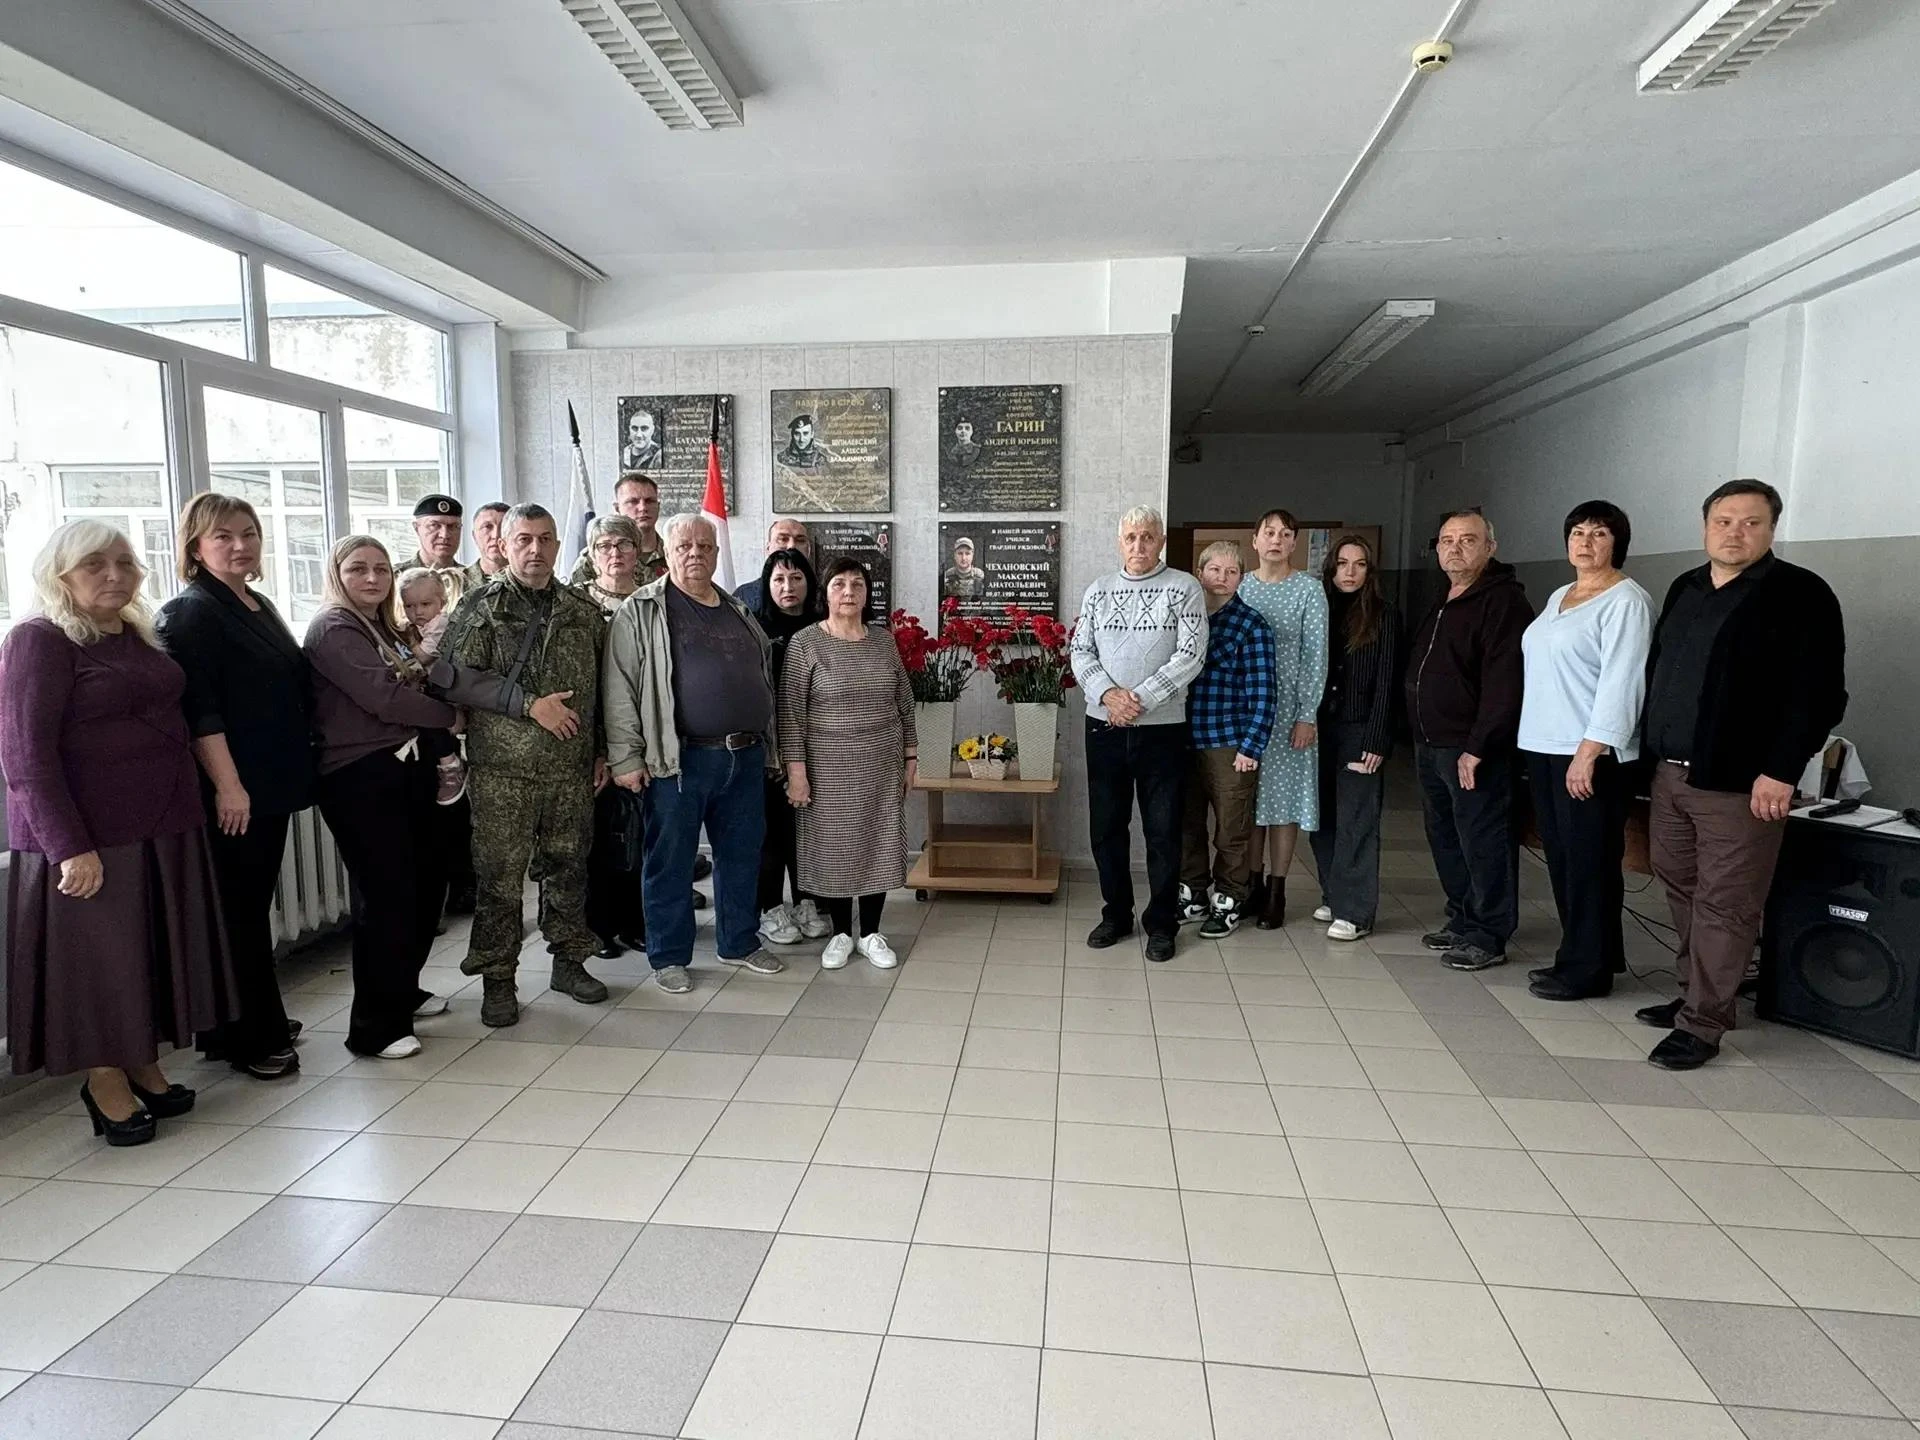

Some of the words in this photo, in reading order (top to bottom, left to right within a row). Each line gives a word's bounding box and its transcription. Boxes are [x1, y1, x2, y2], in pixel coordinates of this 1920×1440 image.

[996, 420, 1045, 433] ГАРИН
[983, 438, 1016, 446] АНДРЕЙ
[1017, 437, 1058, 445] ЮРЬЕВИЧ
[985, 562, 1050, 571] ЧЕХАНОВСКИЙ
